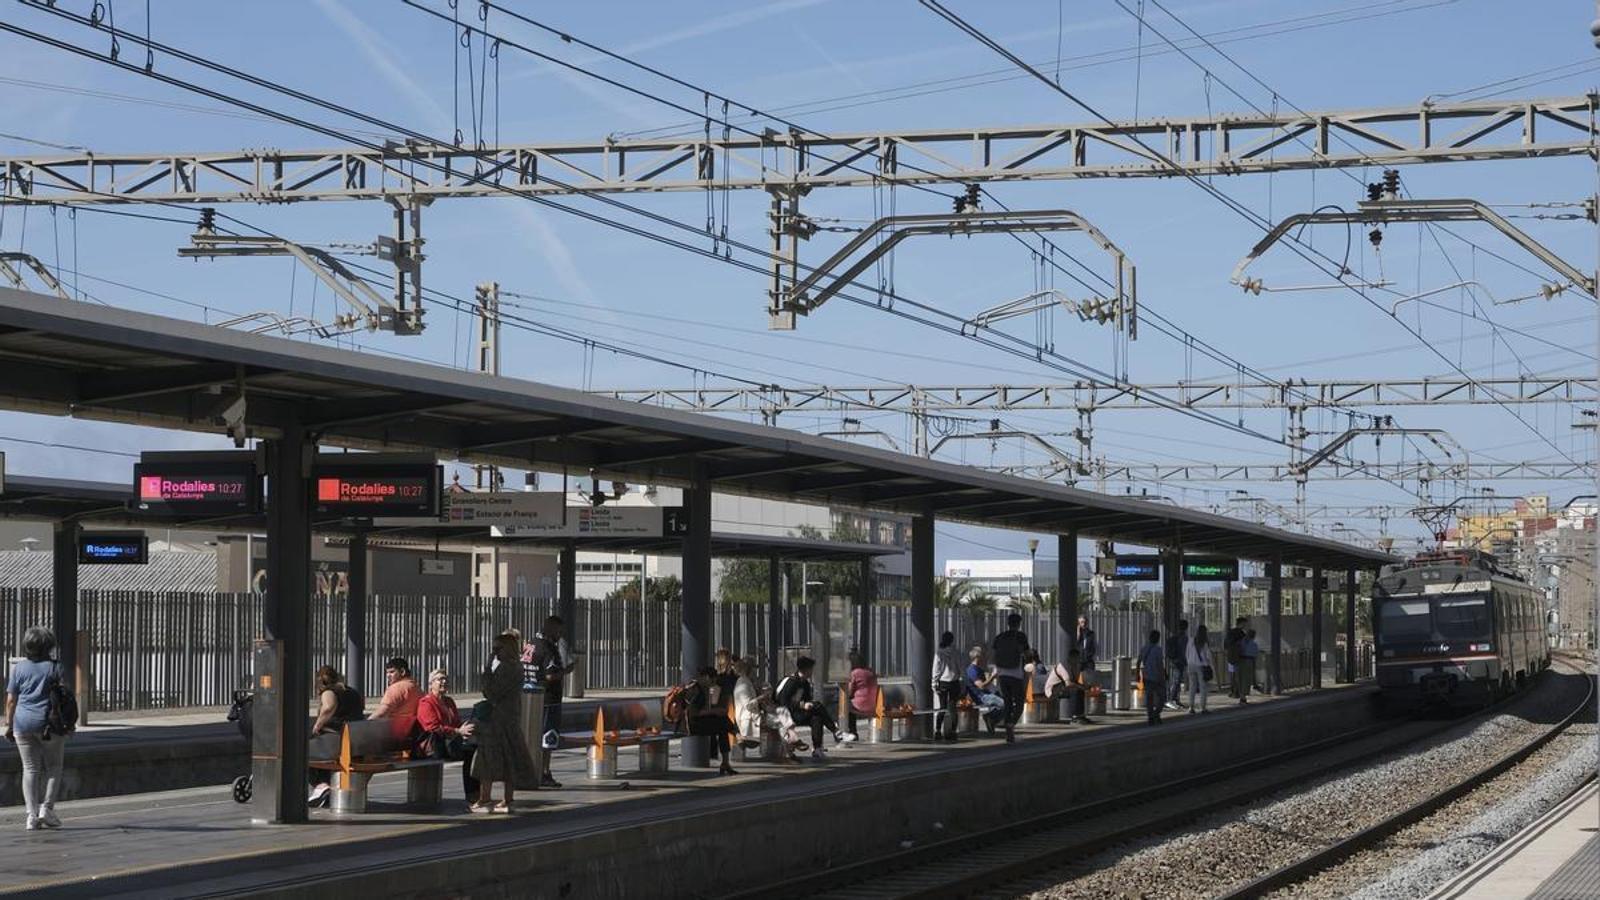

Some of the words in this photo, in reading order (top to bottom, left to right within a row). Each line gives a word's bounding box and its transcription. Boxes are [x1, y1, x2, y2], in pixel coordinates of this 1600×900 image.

[162, 480, 215, 492] Rodalies
[218, 483, 242, 493] 10:27
[341, 483, 395, 495] Rodalies
[399, 486, 423, 497] 10:27
